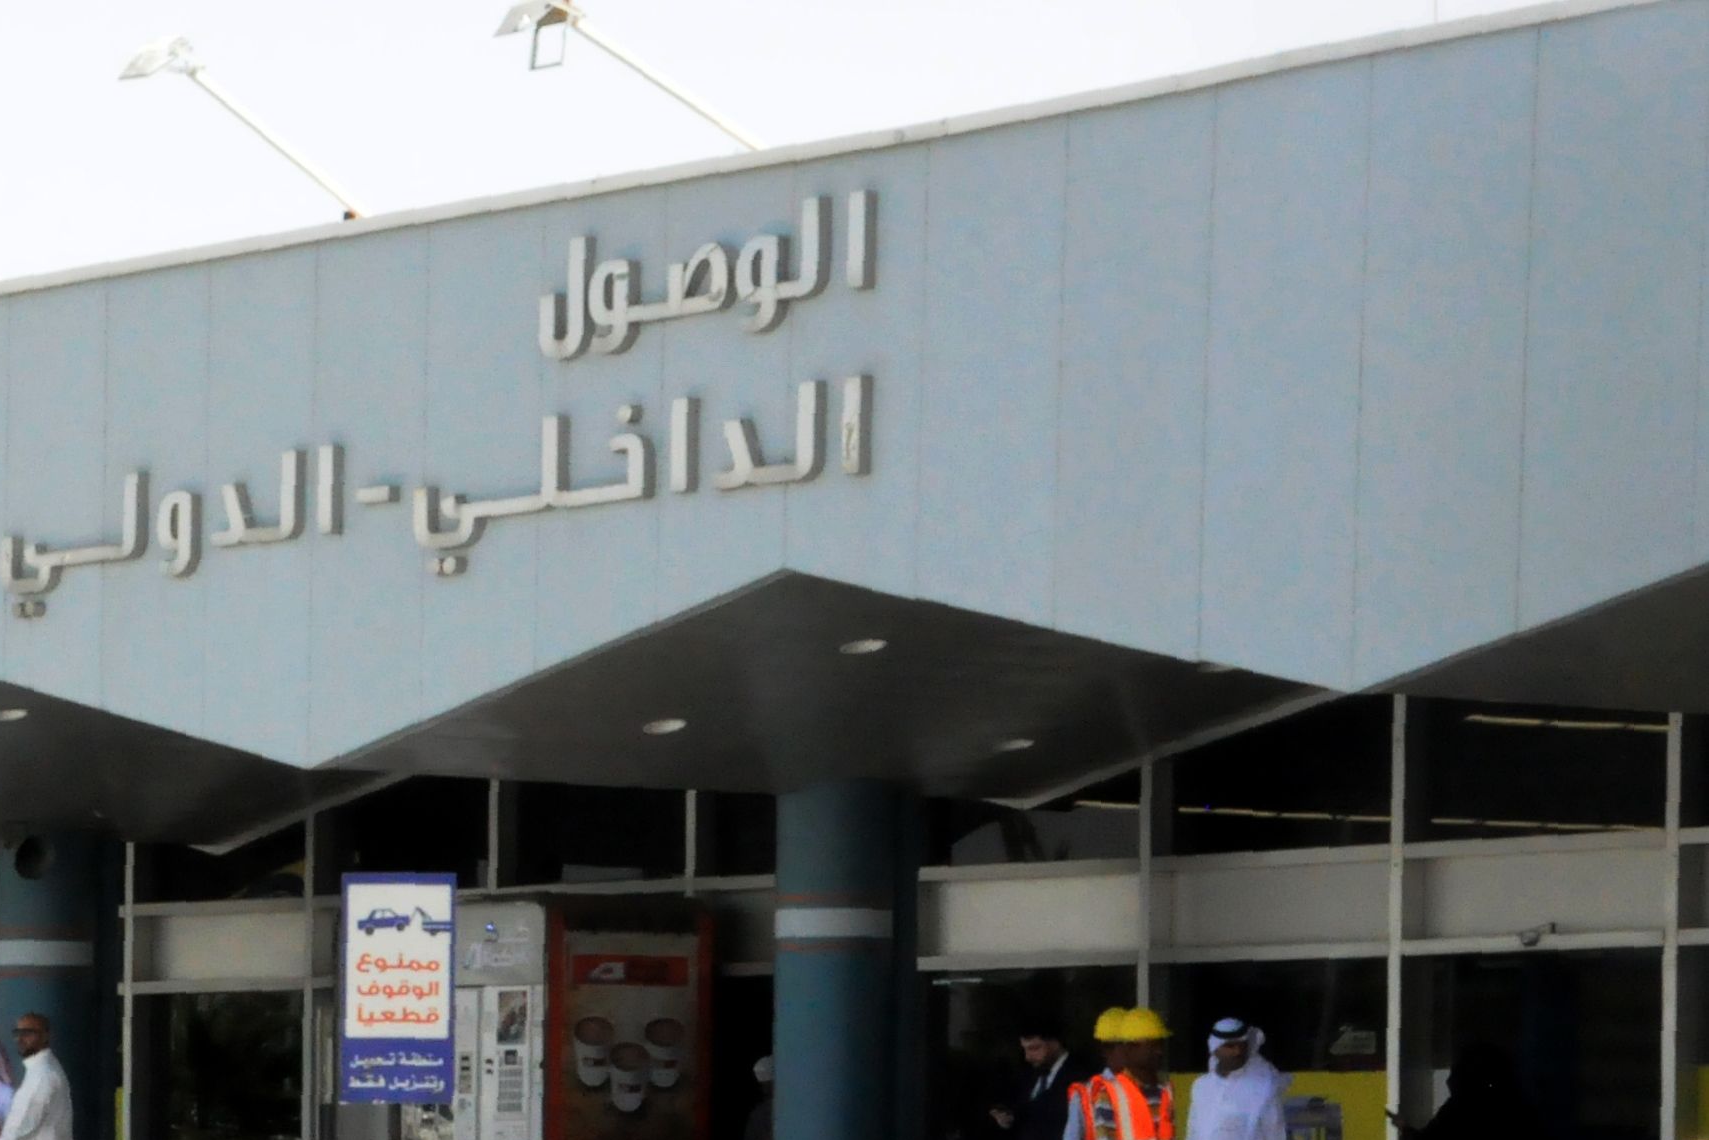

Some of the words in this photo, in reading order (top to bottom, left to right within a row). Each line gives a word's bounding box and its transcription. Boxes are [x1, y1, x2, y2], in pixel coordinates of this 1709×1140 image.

[538, 189, 877, 360] الوصول
[413, 374, 874, 576] الداخلي
[0, 442, 345, 618] الدولي
[356, 952, 440, 973] ممنوع
[357, 979, 440, 999] الوقوف
[348, 1073, 386, 1089] فقط
